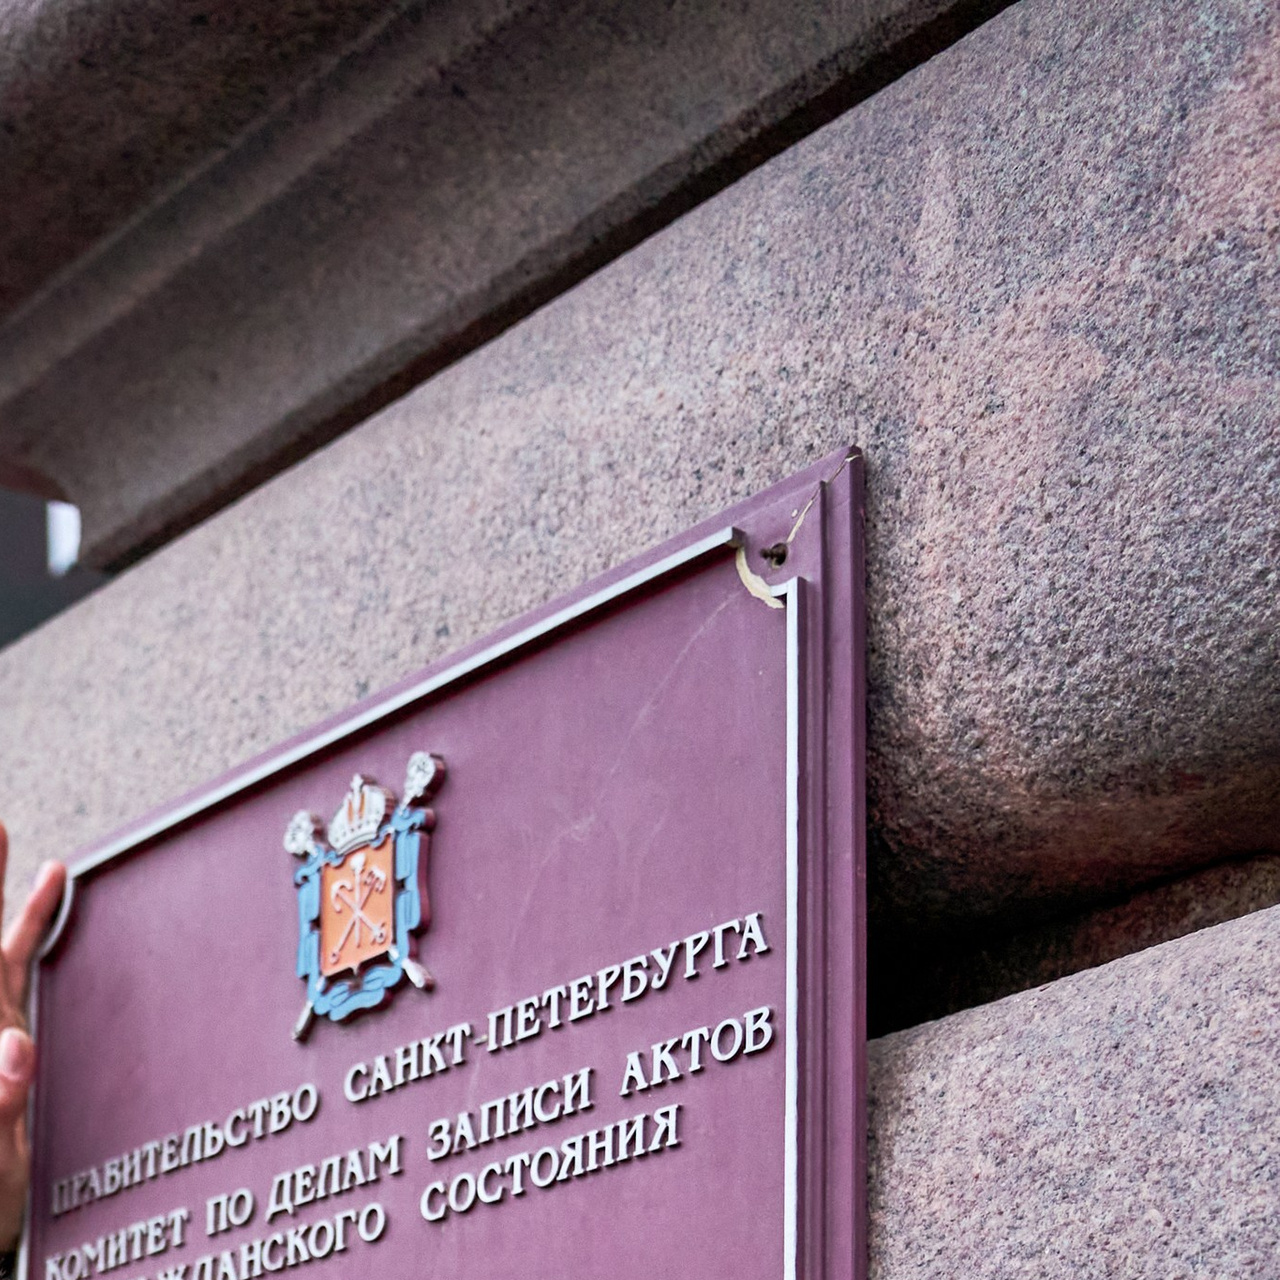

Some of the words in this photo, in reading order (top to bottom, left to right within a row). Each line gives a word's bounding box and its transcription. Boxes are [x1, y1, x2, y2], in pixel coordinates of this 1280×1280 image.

[51, 1082, 318, 1217] ПРАВИТЕЛЬСТВО
[343, 911, 770, 1103] САНКТ-ПЕТЕРБУРГА
[205, 1187, 254, 1236] ПО
[265, 1134, 403, 1222] ДЕЛАМ
[426, 1067, 593, 1161] ЗАПИСИ
[619, 1005, 774, 1097] АКТОВ
[420, 1104, 683, 1222] СОСТОЯНИЯ
